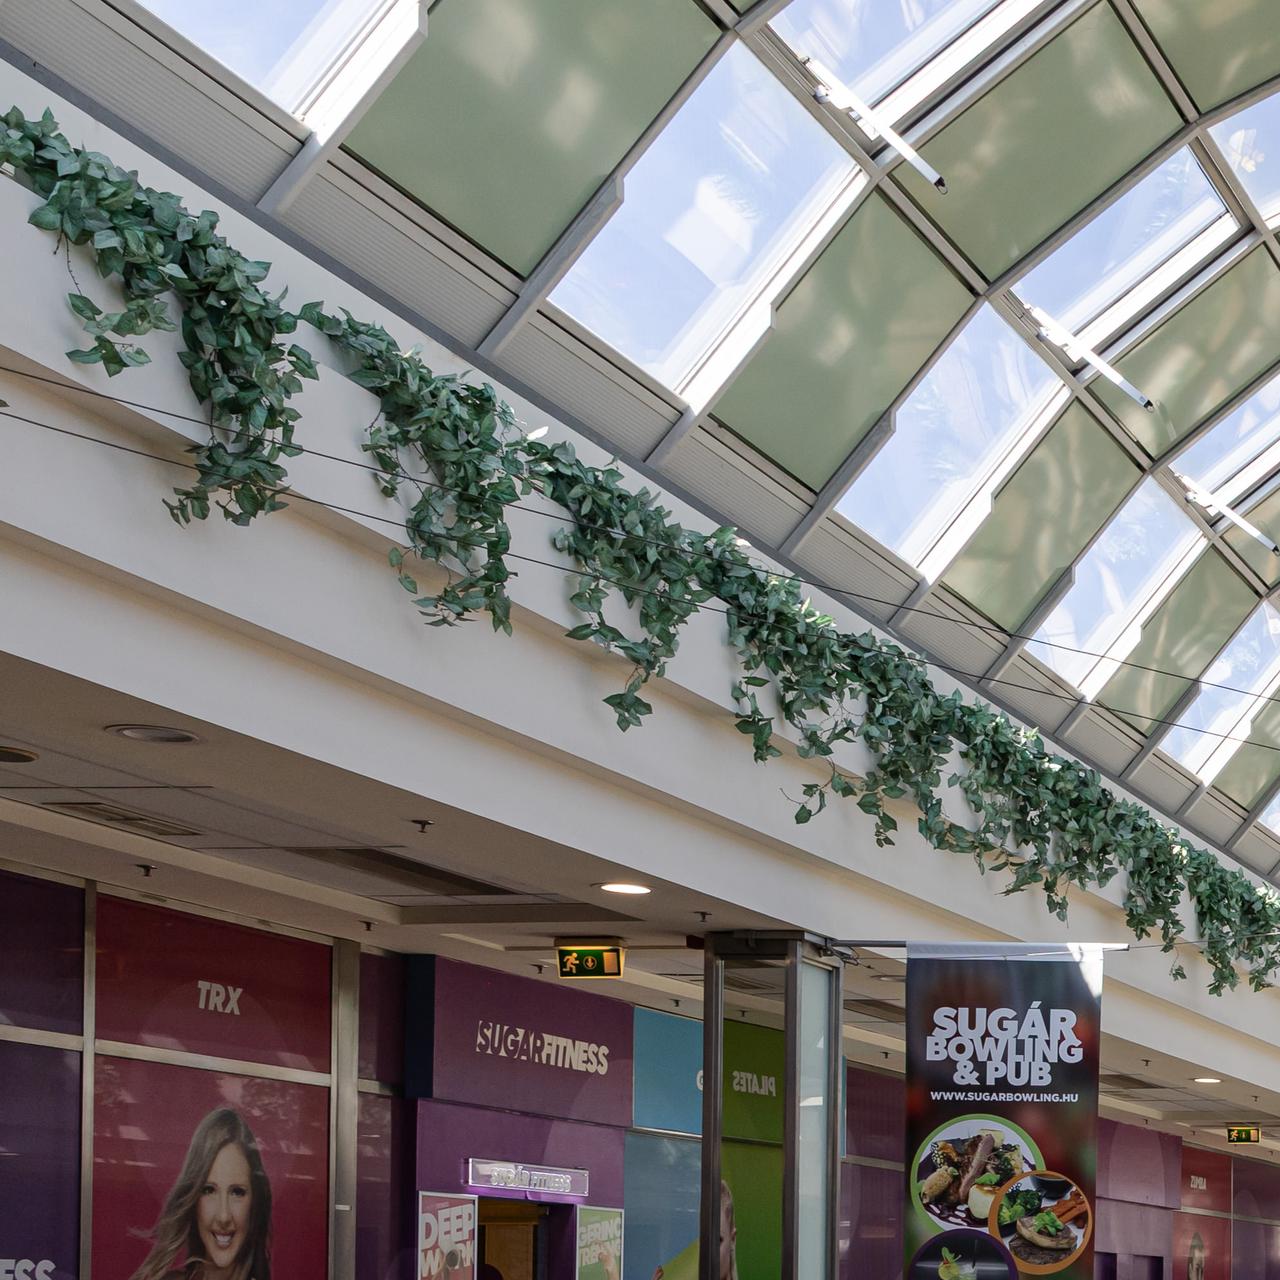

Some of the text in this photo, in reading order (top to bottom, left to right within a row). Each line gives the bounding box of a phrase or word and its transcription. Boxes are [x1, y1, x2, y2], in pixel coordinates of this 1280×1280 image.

[197, 980, 242, 1015] TRX
[932, 1001, 1082, 1042] SUGÁR
[926, 1036, 1083, 1063] BOWLING
[953, 1060, 1052, 1086] & PUB
[931, 1091, 1079, 1102] WWW.SUGARBOWLING.HU
[421, 1203, 474, 1249] DEEP
